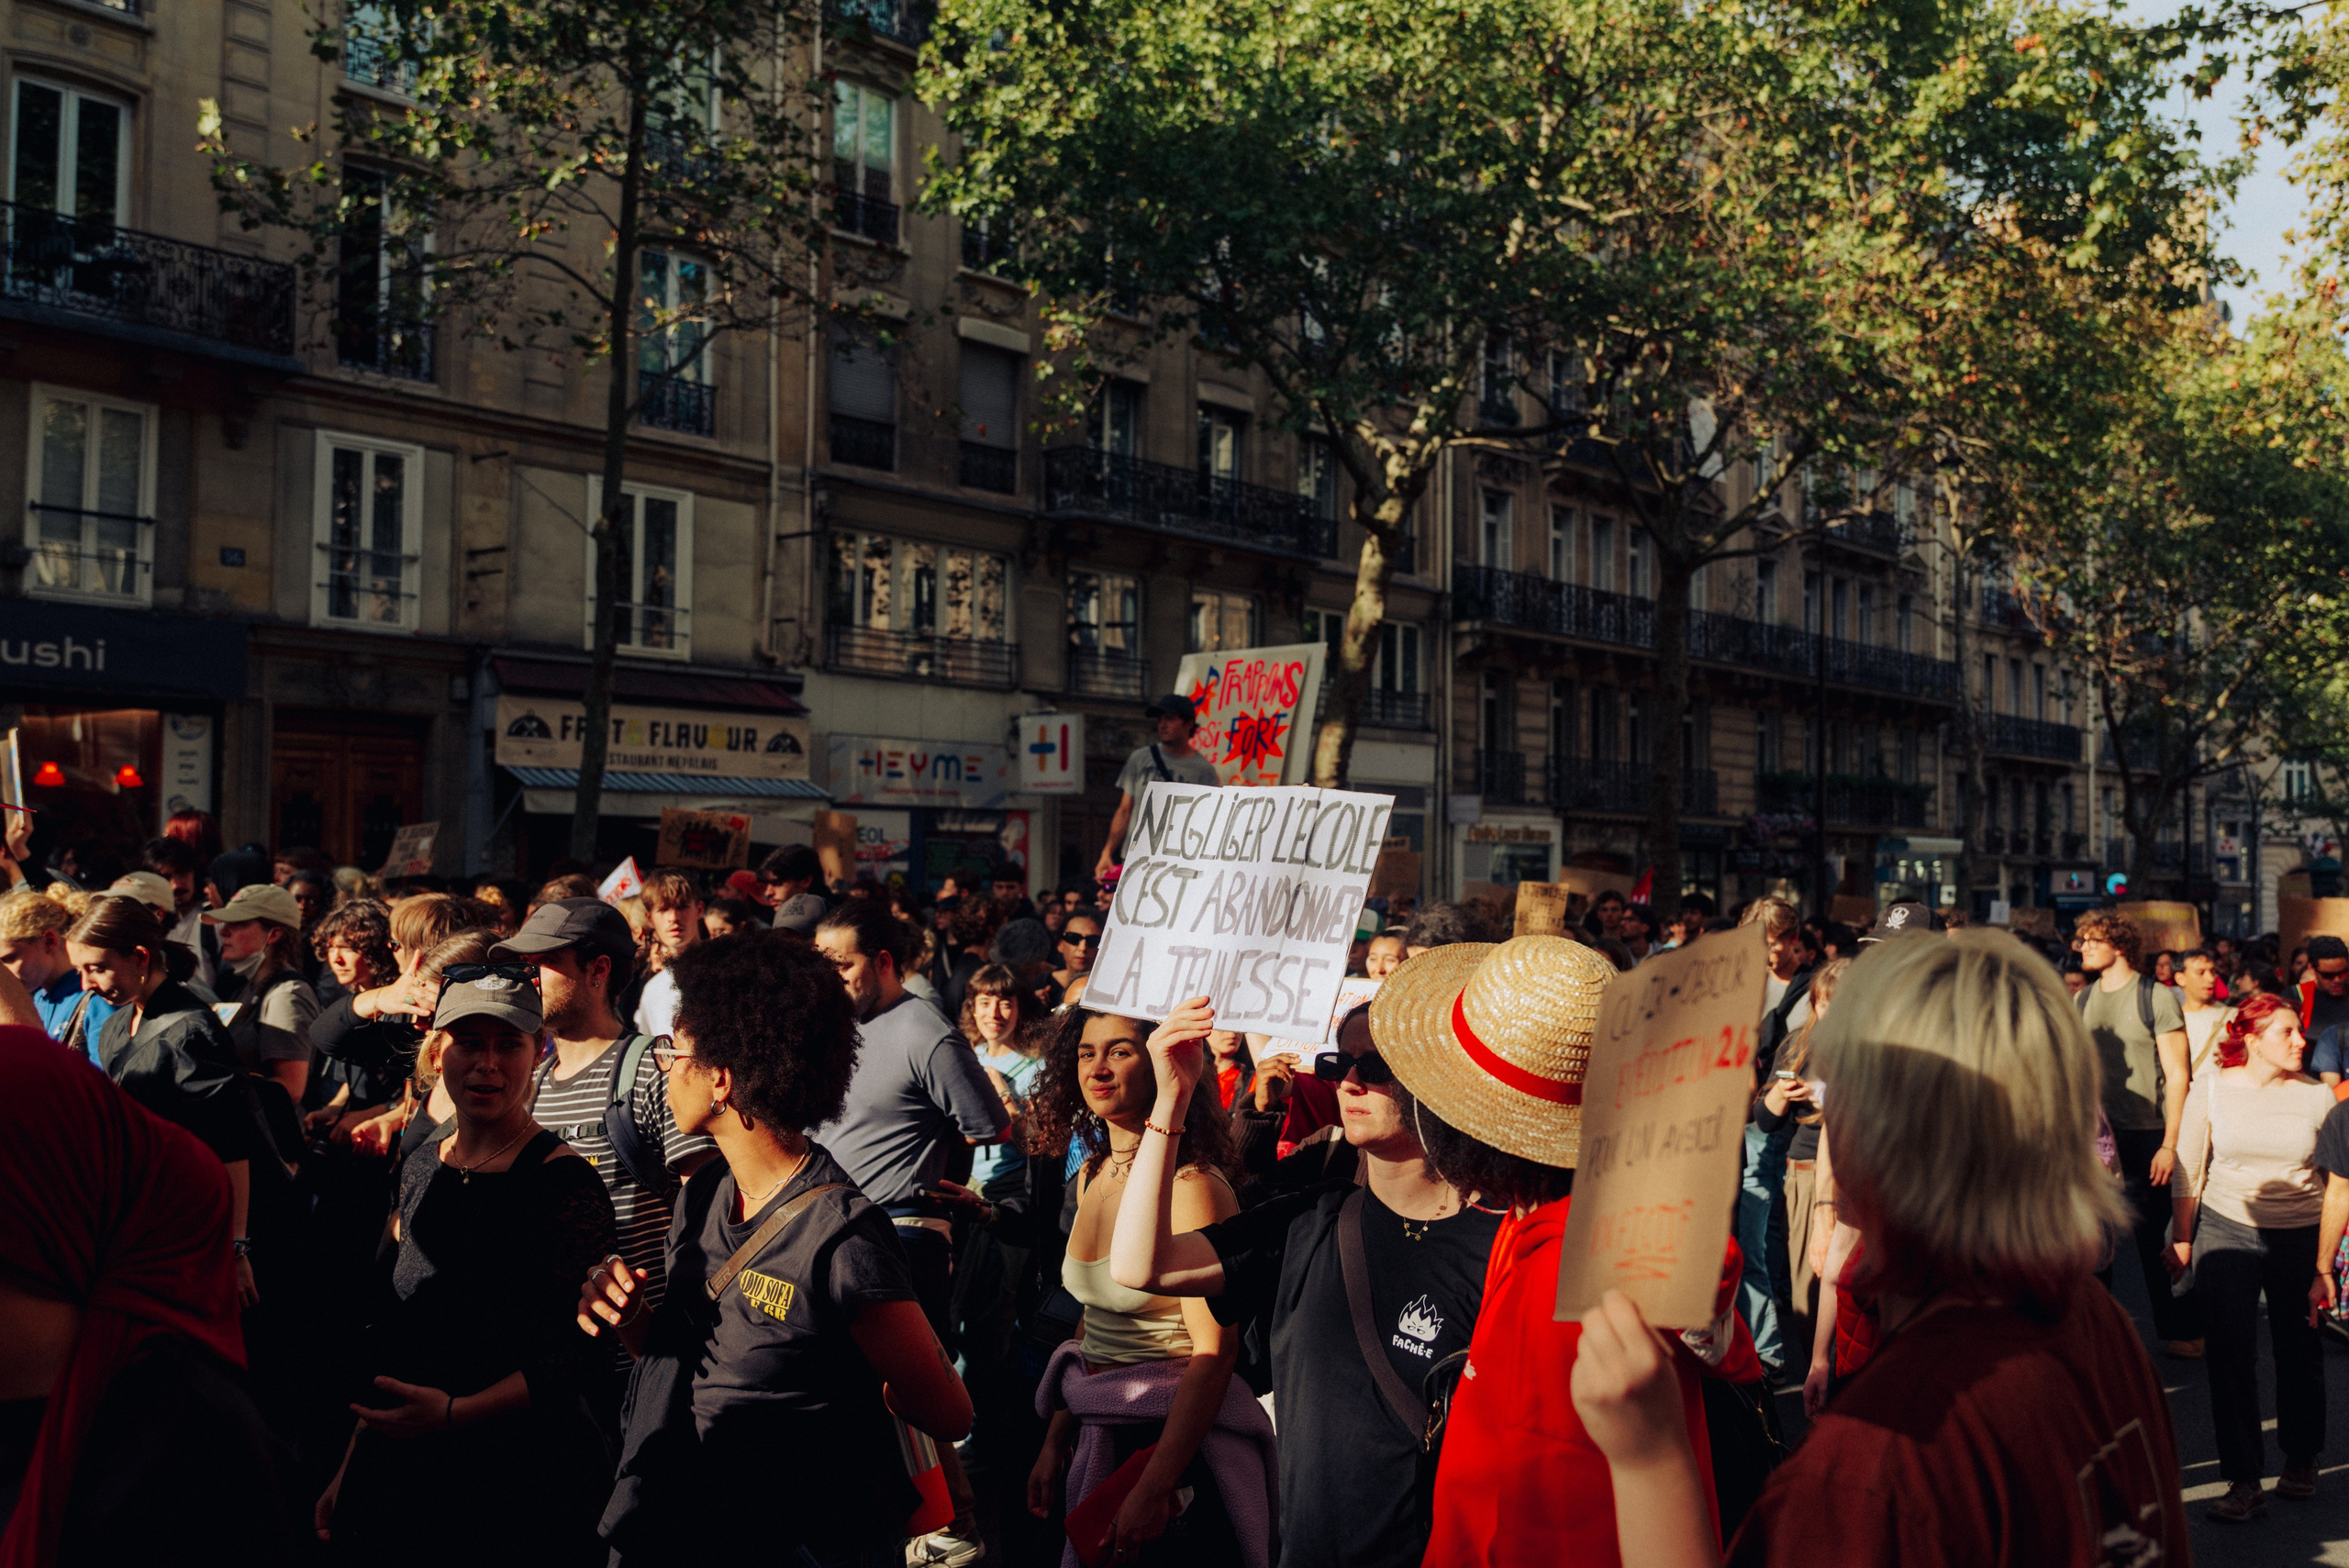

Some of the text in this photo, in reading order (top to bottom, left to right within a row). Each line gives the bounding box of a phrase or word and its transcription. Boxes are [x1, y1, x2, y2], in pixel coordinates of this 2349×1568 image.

[1227, 713, 1288, 759] FORT
[609, 752, 664, 767] STAURANT
[858, 750, 984, 782] HEYME
[1085, 928, 1144, 1006] LA
[1338, 992, 1373, 1007] ATION
[1714, 1024, 1750, 1068] 26
[763, 1279, 792, 1307] SOFA
